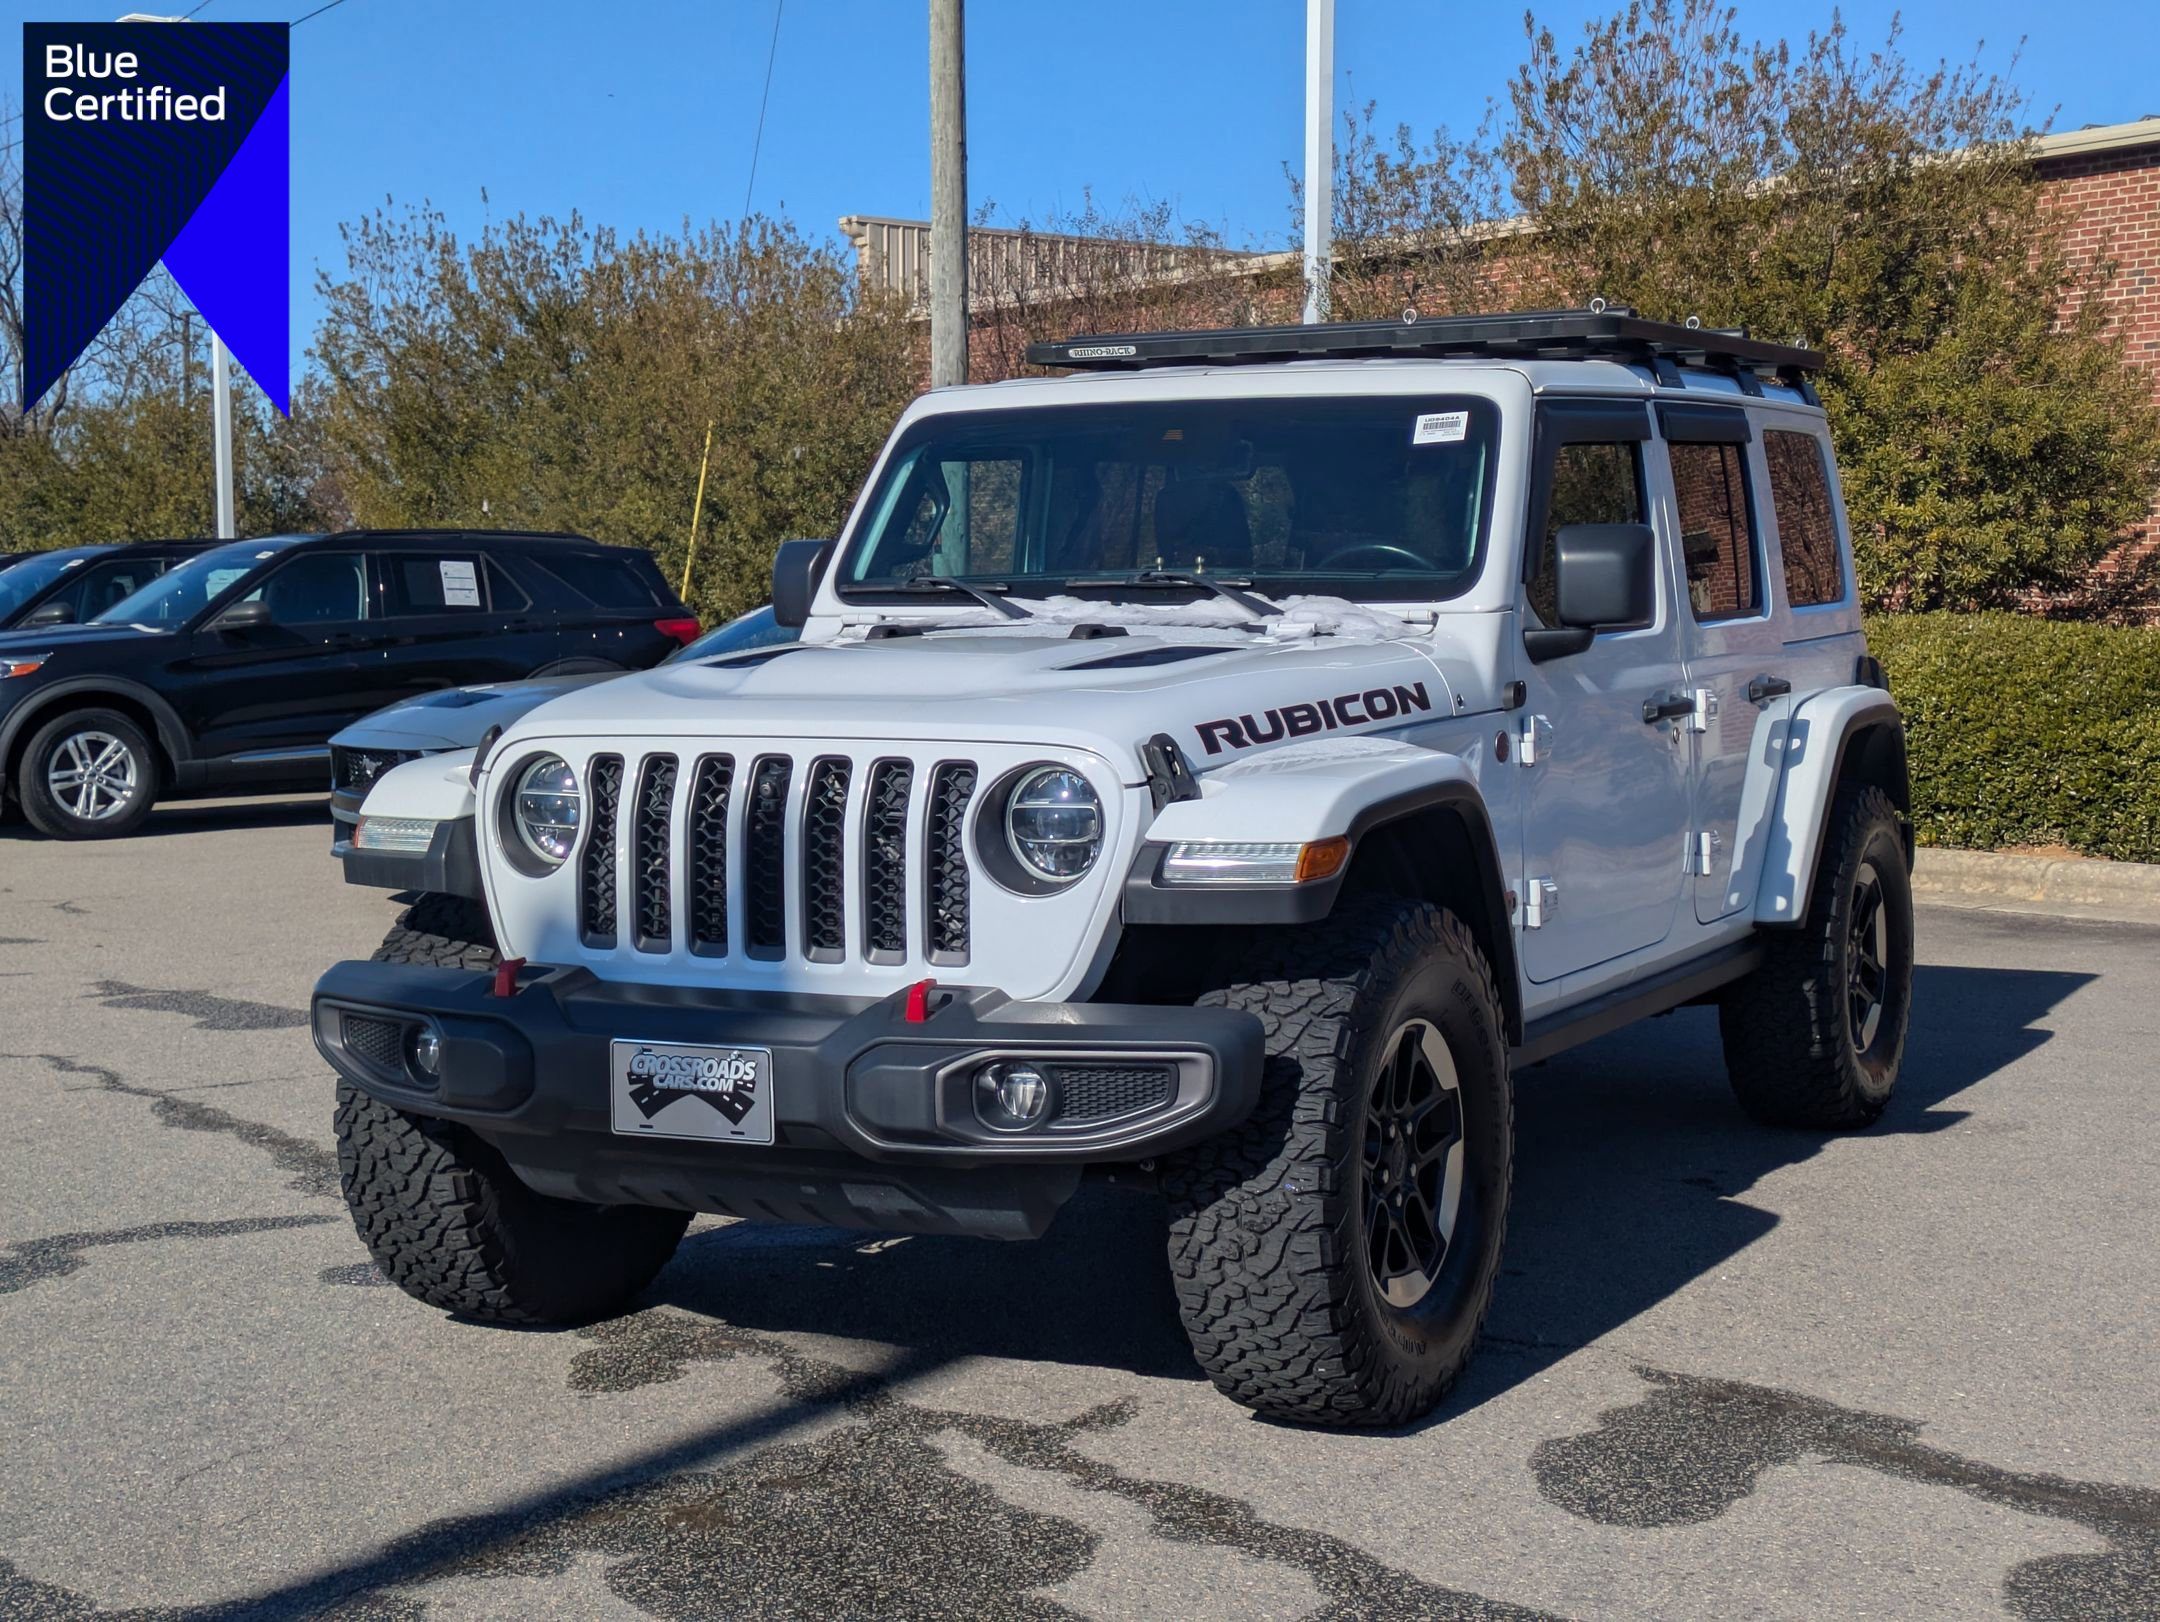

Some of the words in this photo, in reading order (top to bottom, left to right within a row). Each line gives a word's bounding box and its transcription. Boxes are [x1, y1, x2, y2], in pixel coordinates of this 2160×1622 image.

[1074, 346, 1132, 357] RHINO-RACK
[1194, 681, 1432, 755] RUBICON
[630, 1053, 758, 1081] CROSSROADS
[652, 1073, 736, 1093] CARS.COM
